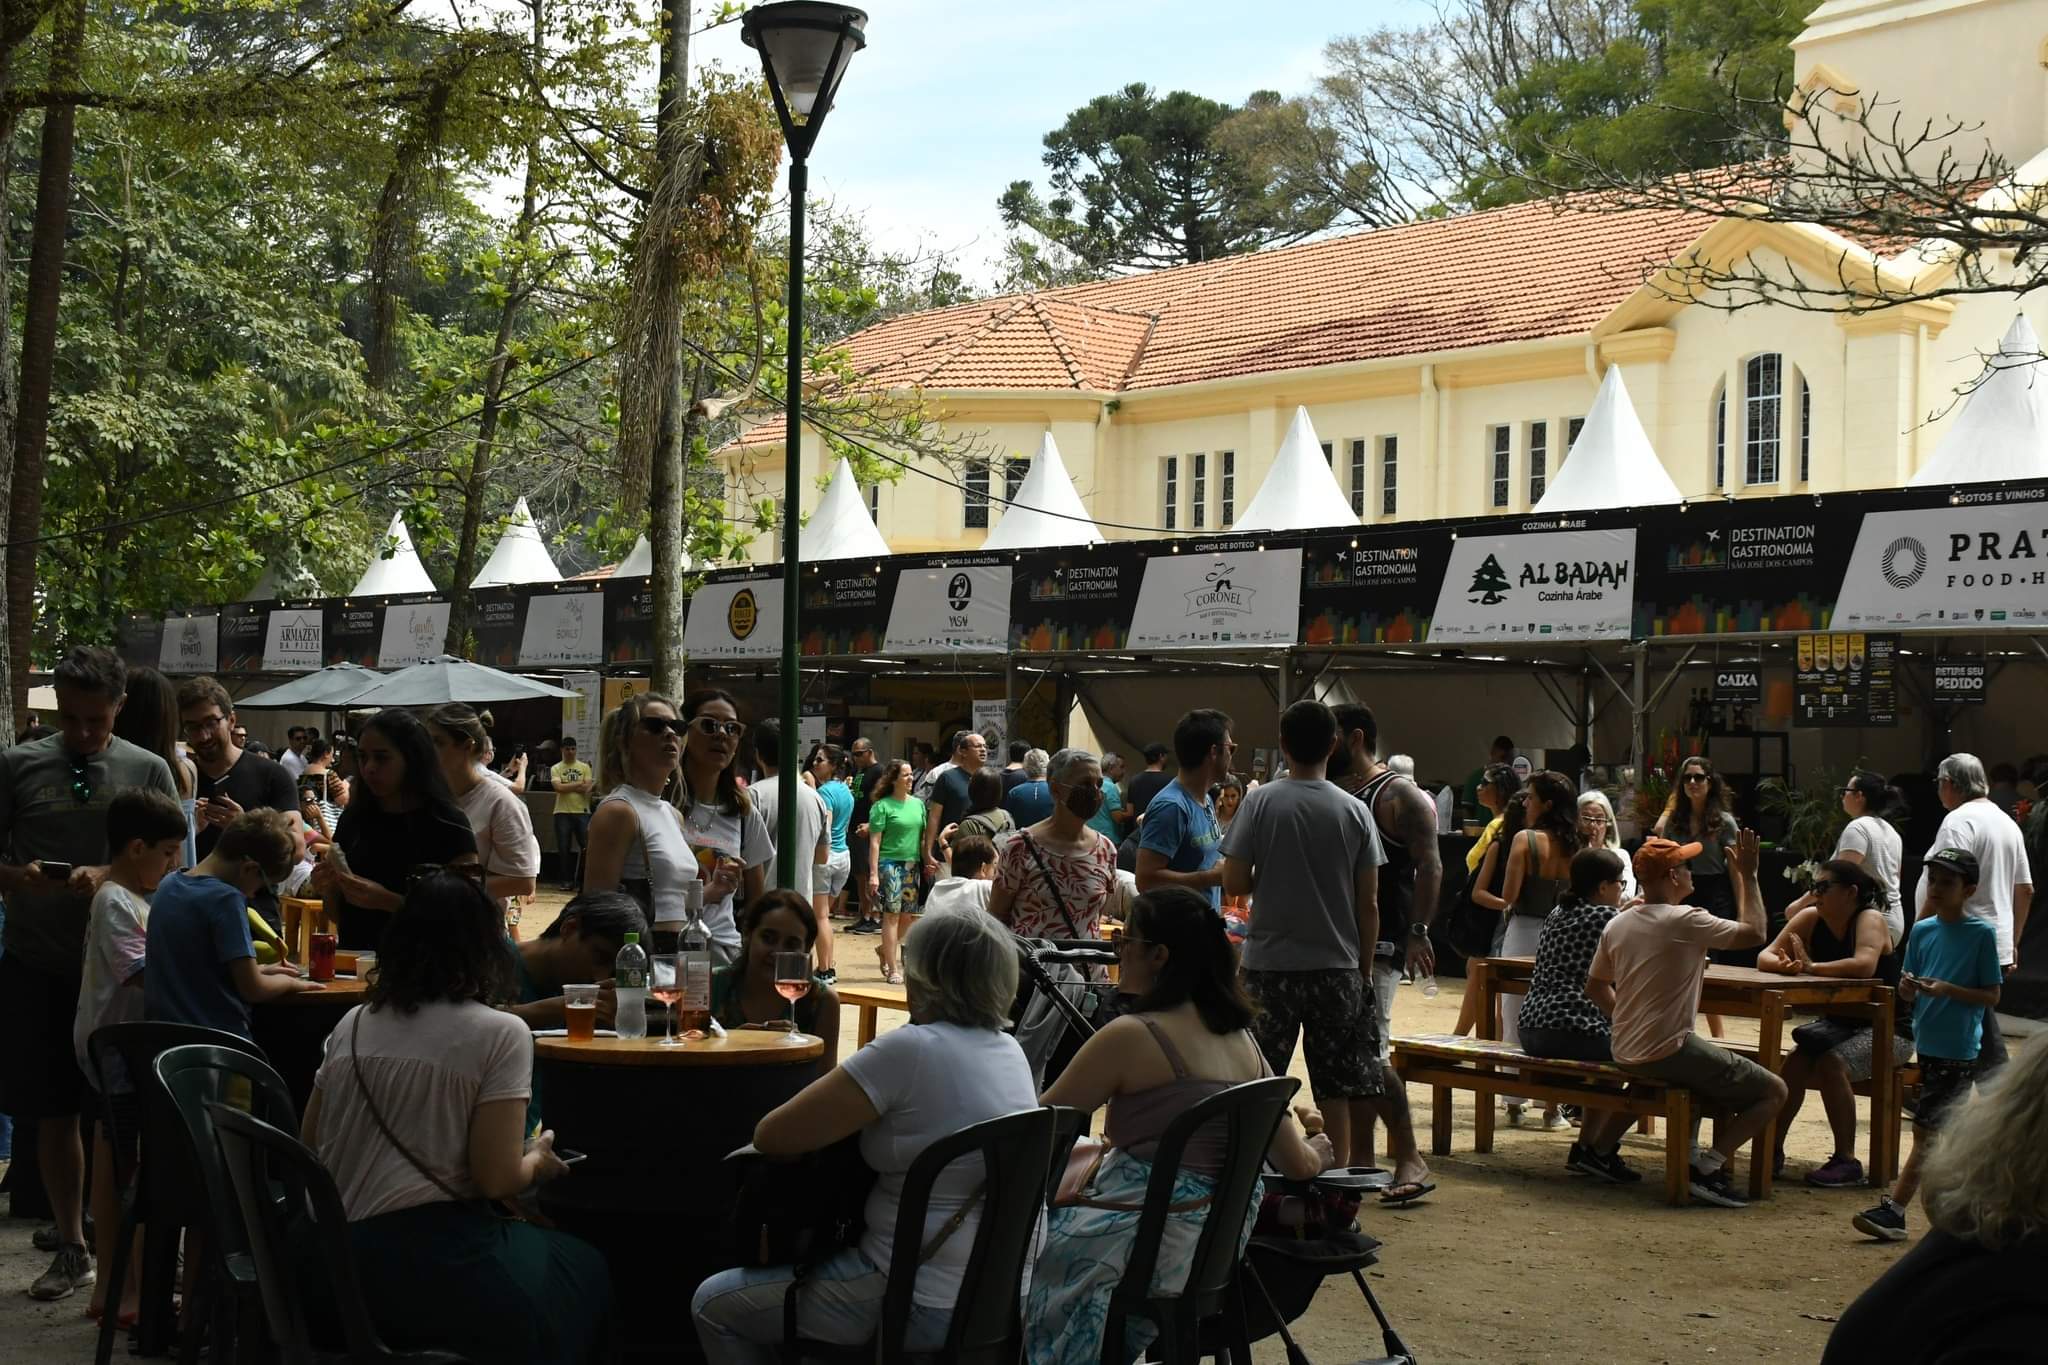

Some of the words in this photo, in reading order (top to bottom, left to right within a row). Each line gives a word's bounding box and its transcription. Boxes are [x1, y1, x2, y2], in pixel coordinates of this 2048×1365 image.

[1995, 491, 2003, 501] E
[2005, 489, 2045, 500] VINHOS
[1522, 521, 1557, 530] COZINHA
[1732, 524, 1815, 542] DESTINATION
[1195, 543, 1218, 551] COMIDA
[1220, 542, 1228, 550] DE
[1229, 541, 1255, 549] BOTECO
[1731, 542, 1814, 558] GASTRONOMIA
[1356, 547, 1418, 562] DESTINATION
[1069, 566, 1119, 579] DESTINATION
[1355, 563, 1417, 576] GASTRONOMIA
[1520, 562, 1550, 588] AL
[1554, 560, 1628, 590] BADAH
[836, 577, 877, 589] DESTINATION
[1069, 579, 1118, 591] GASTRONOMIA
[836, 590, 876, 600] GASTRONOMIA
[1196, 591, 1242, 607] CORONEL
[1538, 590, 1574, 602] Cozinha
[1576, 587, 1603, 601] Árabe
[1935, 666, 1966, 676] RETIRE
[1967, 666, 1984, 676] SEU
[1717, 674, 1758, 687] CAIXA
[1935, 677, 1983, 689] PEDIDO
